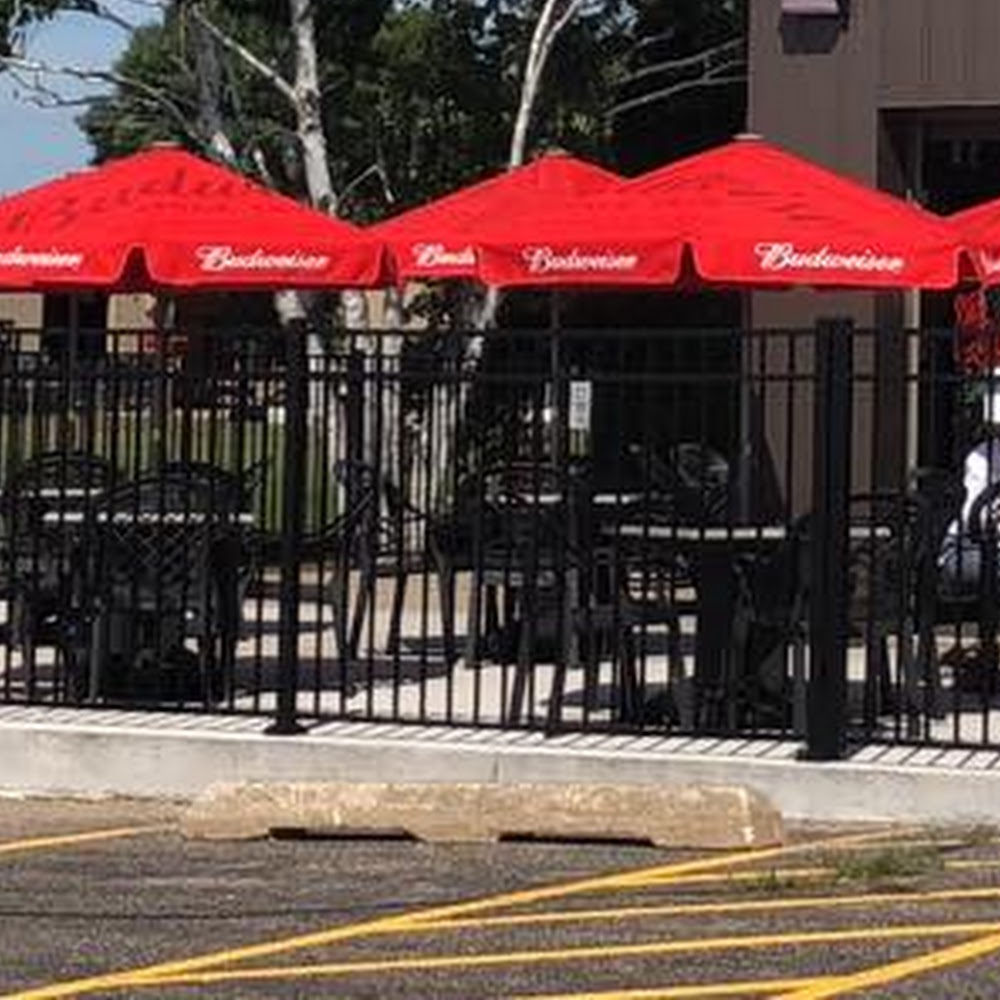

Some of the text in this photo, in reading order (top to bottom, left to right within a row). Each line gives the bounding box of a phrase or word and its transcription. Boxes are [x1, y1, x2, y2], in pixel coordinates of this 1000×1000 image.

[196, 245, 331, 272] Budweiser
[522, 246, 639, 274] Budweiser
[752, 242, 905, 273] Budweiser
